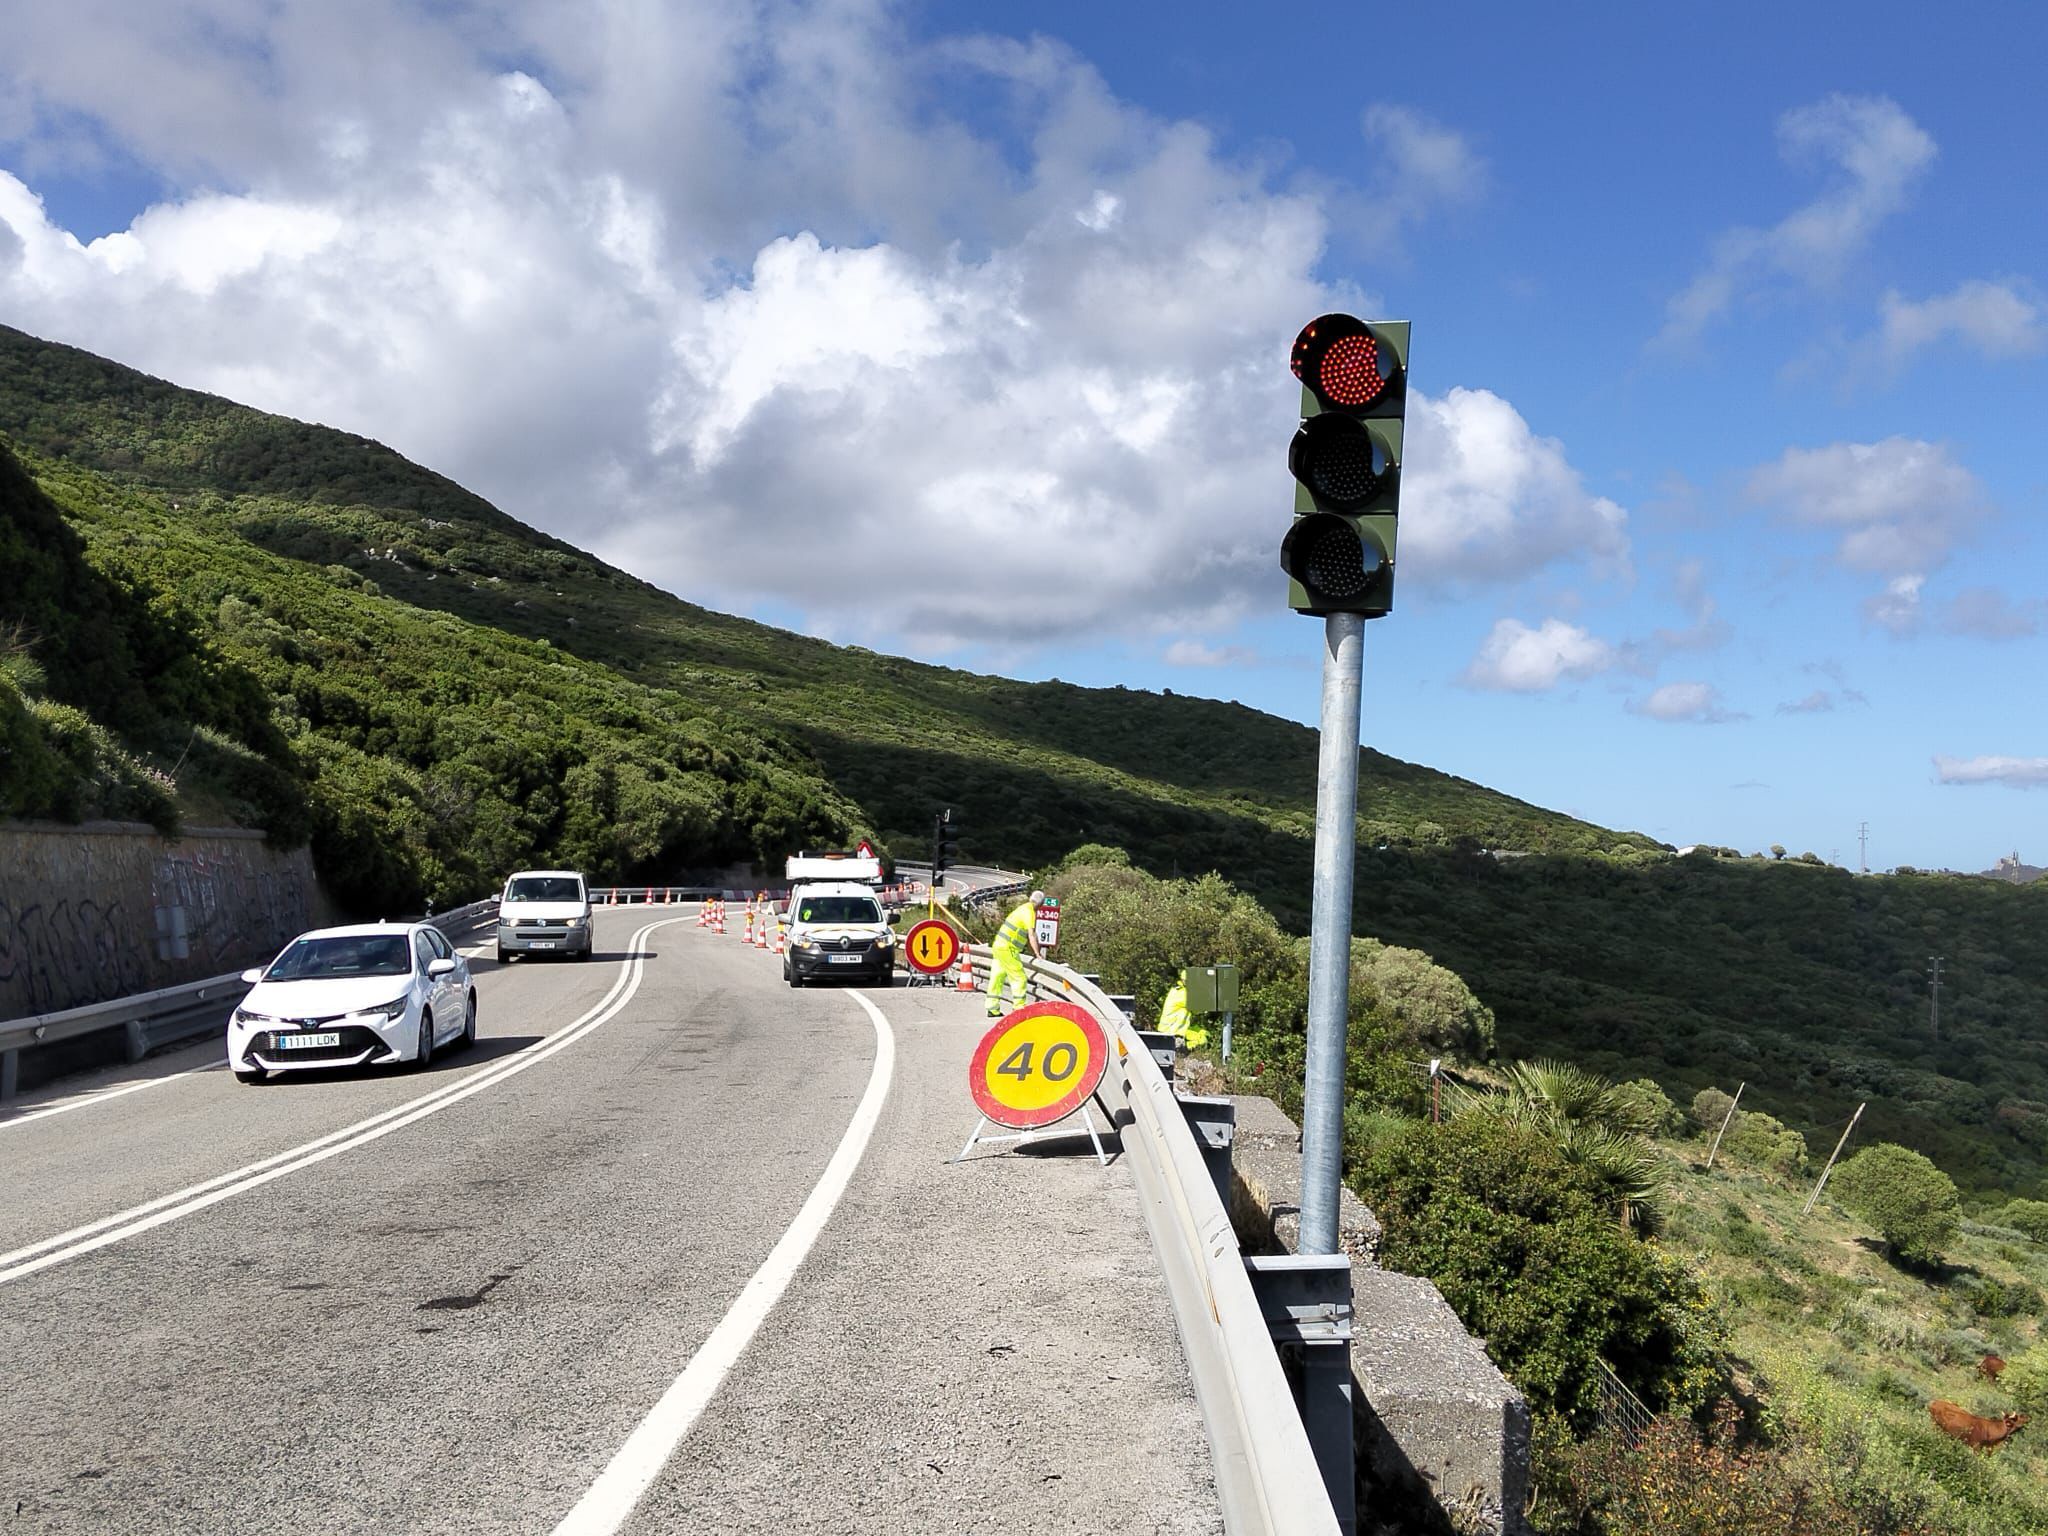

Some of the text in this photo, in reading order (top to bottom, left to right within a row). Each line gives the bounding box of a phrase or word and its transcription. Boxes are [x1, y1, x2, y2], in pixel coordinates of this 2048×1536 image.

[1037, 910, 1058, 919] N-340
[1040, 932, 1050, 942] 91
[289, 1034, 337, 1048] 1111 LDK
[997, 1042, 1078, 1081] 40
